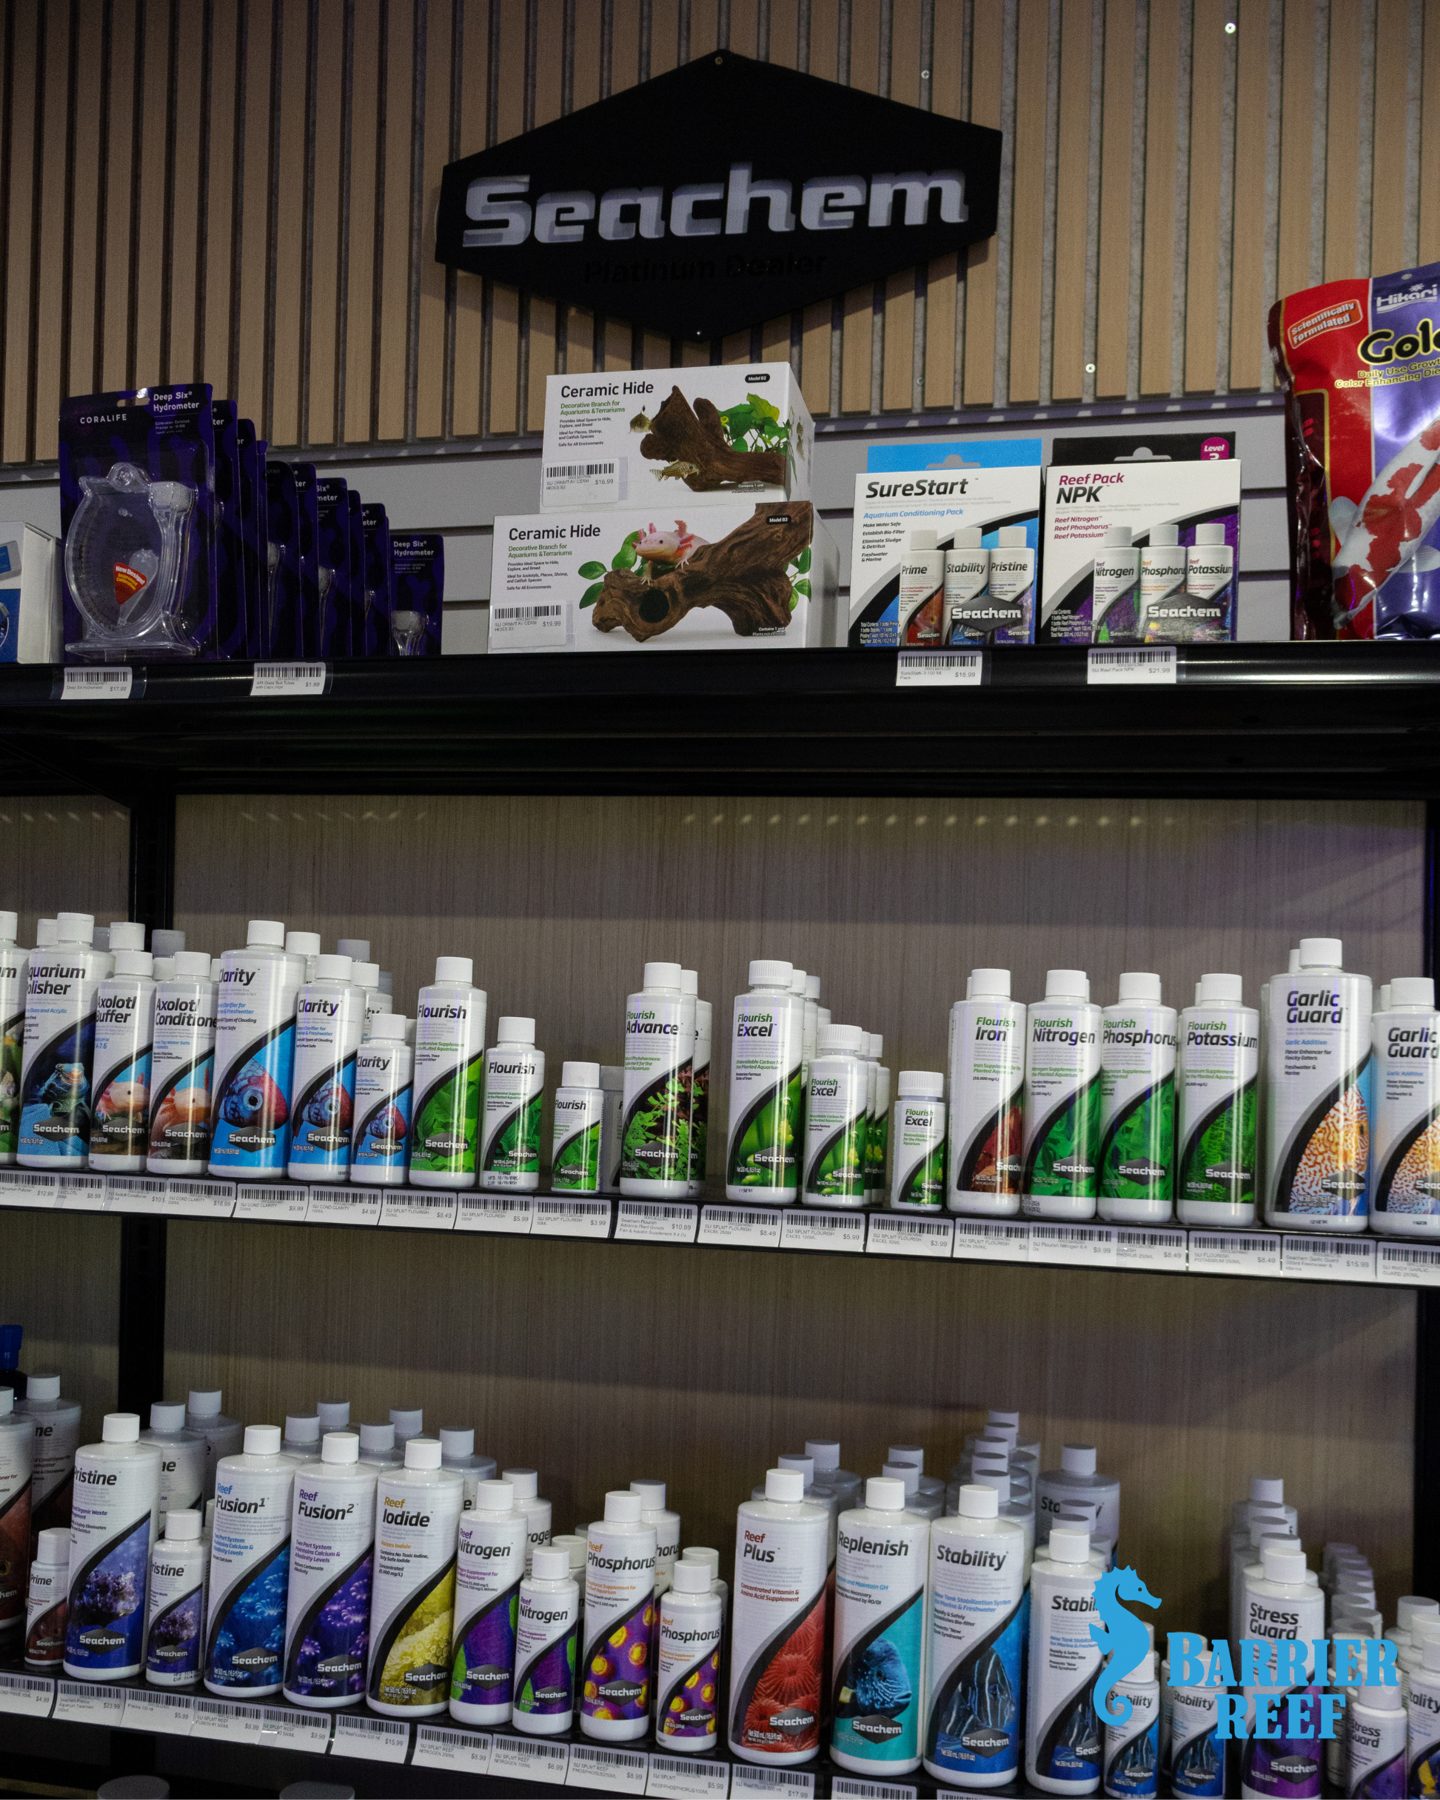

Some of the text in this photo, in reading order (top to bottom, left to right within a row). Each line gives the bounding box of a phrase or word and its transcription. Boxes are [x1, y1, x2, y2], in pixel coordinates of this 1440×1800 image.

[463, 162, 969, 247] Seachem
[1376, 284, 1438, 307] Hikari
[1291, 302, 1355, 335] Scientifically
[1293, 314, 1351, 344] Formulated
[1358, 370, 1384, 378] Daily
[1386, 366, 1408, 375] Use
[1334, 368, 1440, 388] Color Enhancing Die
[561, 381, 654, 398] Ceramic Hide
[154, 393, 173, 402] Deep
[153, 402, 200, 412] Hydrometer
[80, 414, 127, 424] CORALIFE
[1204, 444, 1224, 453] Level
[1059, 473, 1125, 485] Reef Pack
[866, 479, 968, 498] SureStart
[1056, 486, 1102, 504] NPK
[509, 524, 600, 540] Ceramic Hide
[901, 564, 928, 575] Prime
[946, 562, 986, 574] Stability
[991, 562, 1028, 572] Pristine
[1096, 567, 1134, 578] Nitrogen
[952, 608, 1022, 619] Seachem
[1149, 606, 1221, 617] Seachem
[28, 964, 86, 980] quarium
[1287, 990, 1340, 1006] Garlic
[299, 1000, 339, 1016] Clarity
[418, 1005, 466, 1019] Flourish
[155, 1012, 217, 1028] Conditione
[738, 1014, 772, 1022] Flourish
[1287, 1007, 1343, 1023] Guard
[976, 1017, 1015, 1027] Flourish
[1033, 1019, 1073, 1028] Flourish
[1103, 1019, 1136, 1028] Flourish
[1188, 1022, 1227, 1030] Flourish
[627, 1021, 678, 1035] Advance
[737, 1024, 772, 1037] Excel
[976, 1027, 1007, 1041] Iron
[1033, 1028, 1095, 1046] Nitrogen
[1103, 1030, 1176, 1046] Phosphorus
[1388, 1027, 1437, 1043] Garlic
[1187, 1032, 1258, 1048] Potassium
[489, 1062, 535, 1075] Flourish
[811, 1086, 838, 1096] Excel
[905, 1116, 932, 1126] Excel
[34, 1124, 80, 1134] Seachem
[103, 1124, 145, 1134] Seachem
[229, 1134, 276, 1144] Seachem
[307, 1133, 349, 1143] Seachem
[370, 1142, 403, 1151] Seachem
[425, 1139, 468, 1150] Seachem
[635, 1148, 679, 1158] Seachem
[755, 1154, 795, 1163] Seachem
[560, 1168, 588, 1176] Seachem
[1053, 1163, 1094, 1173] Seachem
[1119, 1166, 1165, 1176] Seachem
[1206, 1168, 1251, 1179] Seachem
[218, 1483, 232, 1494] Reef
[299, 1489, 318, 1501] Reef
[384, 1496, 405, 1508] Reef
[383, 1509, 430, 1527] Iodide
[744, 1530, 765, 1543] Reef
[313, 1543, 332, 1551] System
[460, 1538, 510, 1559] Nitrogen
[589, 1541, 602, 1552] Reef
[838, 1535, 908, 1556] Replenish
[744, 1543, 775, 1563] Plus
[937, 1545, 1006, 1571] Stability
[588, 1552, 655, 1572] Phosphorus
[30, 1575, 52, 1586] Prime
[741, 1582, 771, 1594] Concentrated
[957, 1597, 993, 1605] Stabilization
[520, 1605, 568, 1623] Nitrogen
[1250, 1602, 1299, 1624] Stress
[662, 1625, 720, 1643] Phosphorus
[1250, 1618, 1298, 1640] Guard
[79, 1635, 125, 1645] Seachem
[232, 1655, 278, 1665] Seachem
[317, 1662, 362, 1672] Seachem
[405, 1671, 448, 1681] Seachem
[466, 1670, 509, 1681] Seachem
[599, 1686, 642, 1697] Seachem
[680, 1713, 712, 1721] Seachem
[770, 1715, 814, 1726] Seachem
[853, 1720, 902, 1734] Seachem
[962, 1736, 1009, 1747] Seachem
[1271, 1761, 1317, 1773] Seachem
